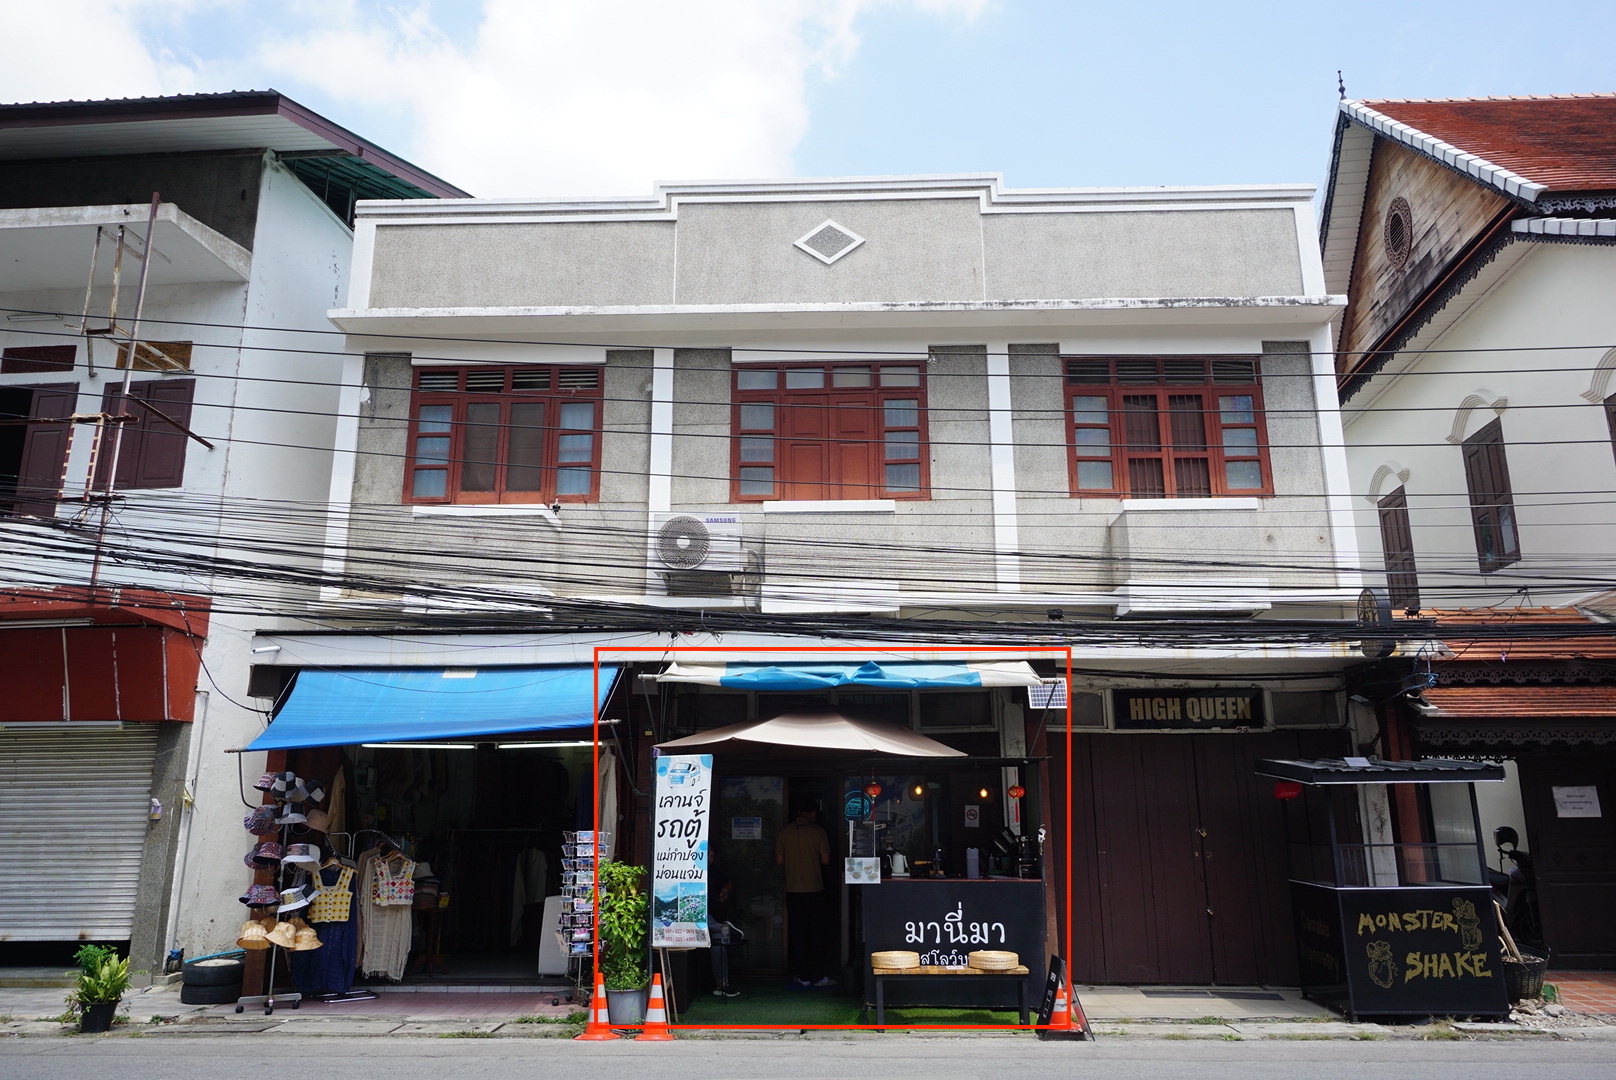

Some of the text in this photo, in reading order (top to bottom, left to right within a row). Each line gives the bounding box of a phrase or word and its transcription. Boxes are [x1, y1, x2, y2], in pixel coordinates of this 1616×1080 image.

[1129, 697, 1252, 723] HIGH QUEEN
[658, 788, 707, 808] เลานจ์
[657, 809, 706, 849] รถตู้
[656, 847, 704, 861] แม่กำปอง
[656, 864, 703, 880] ม่อนแจ่ม
[904, 901, 1006, 944] มานี่มา
[1357, 909, 1459, 936] MONSTER
[920, 948, 969, 966] สโลว์บ
[1404, 951, 1493, 985] SHAKE
